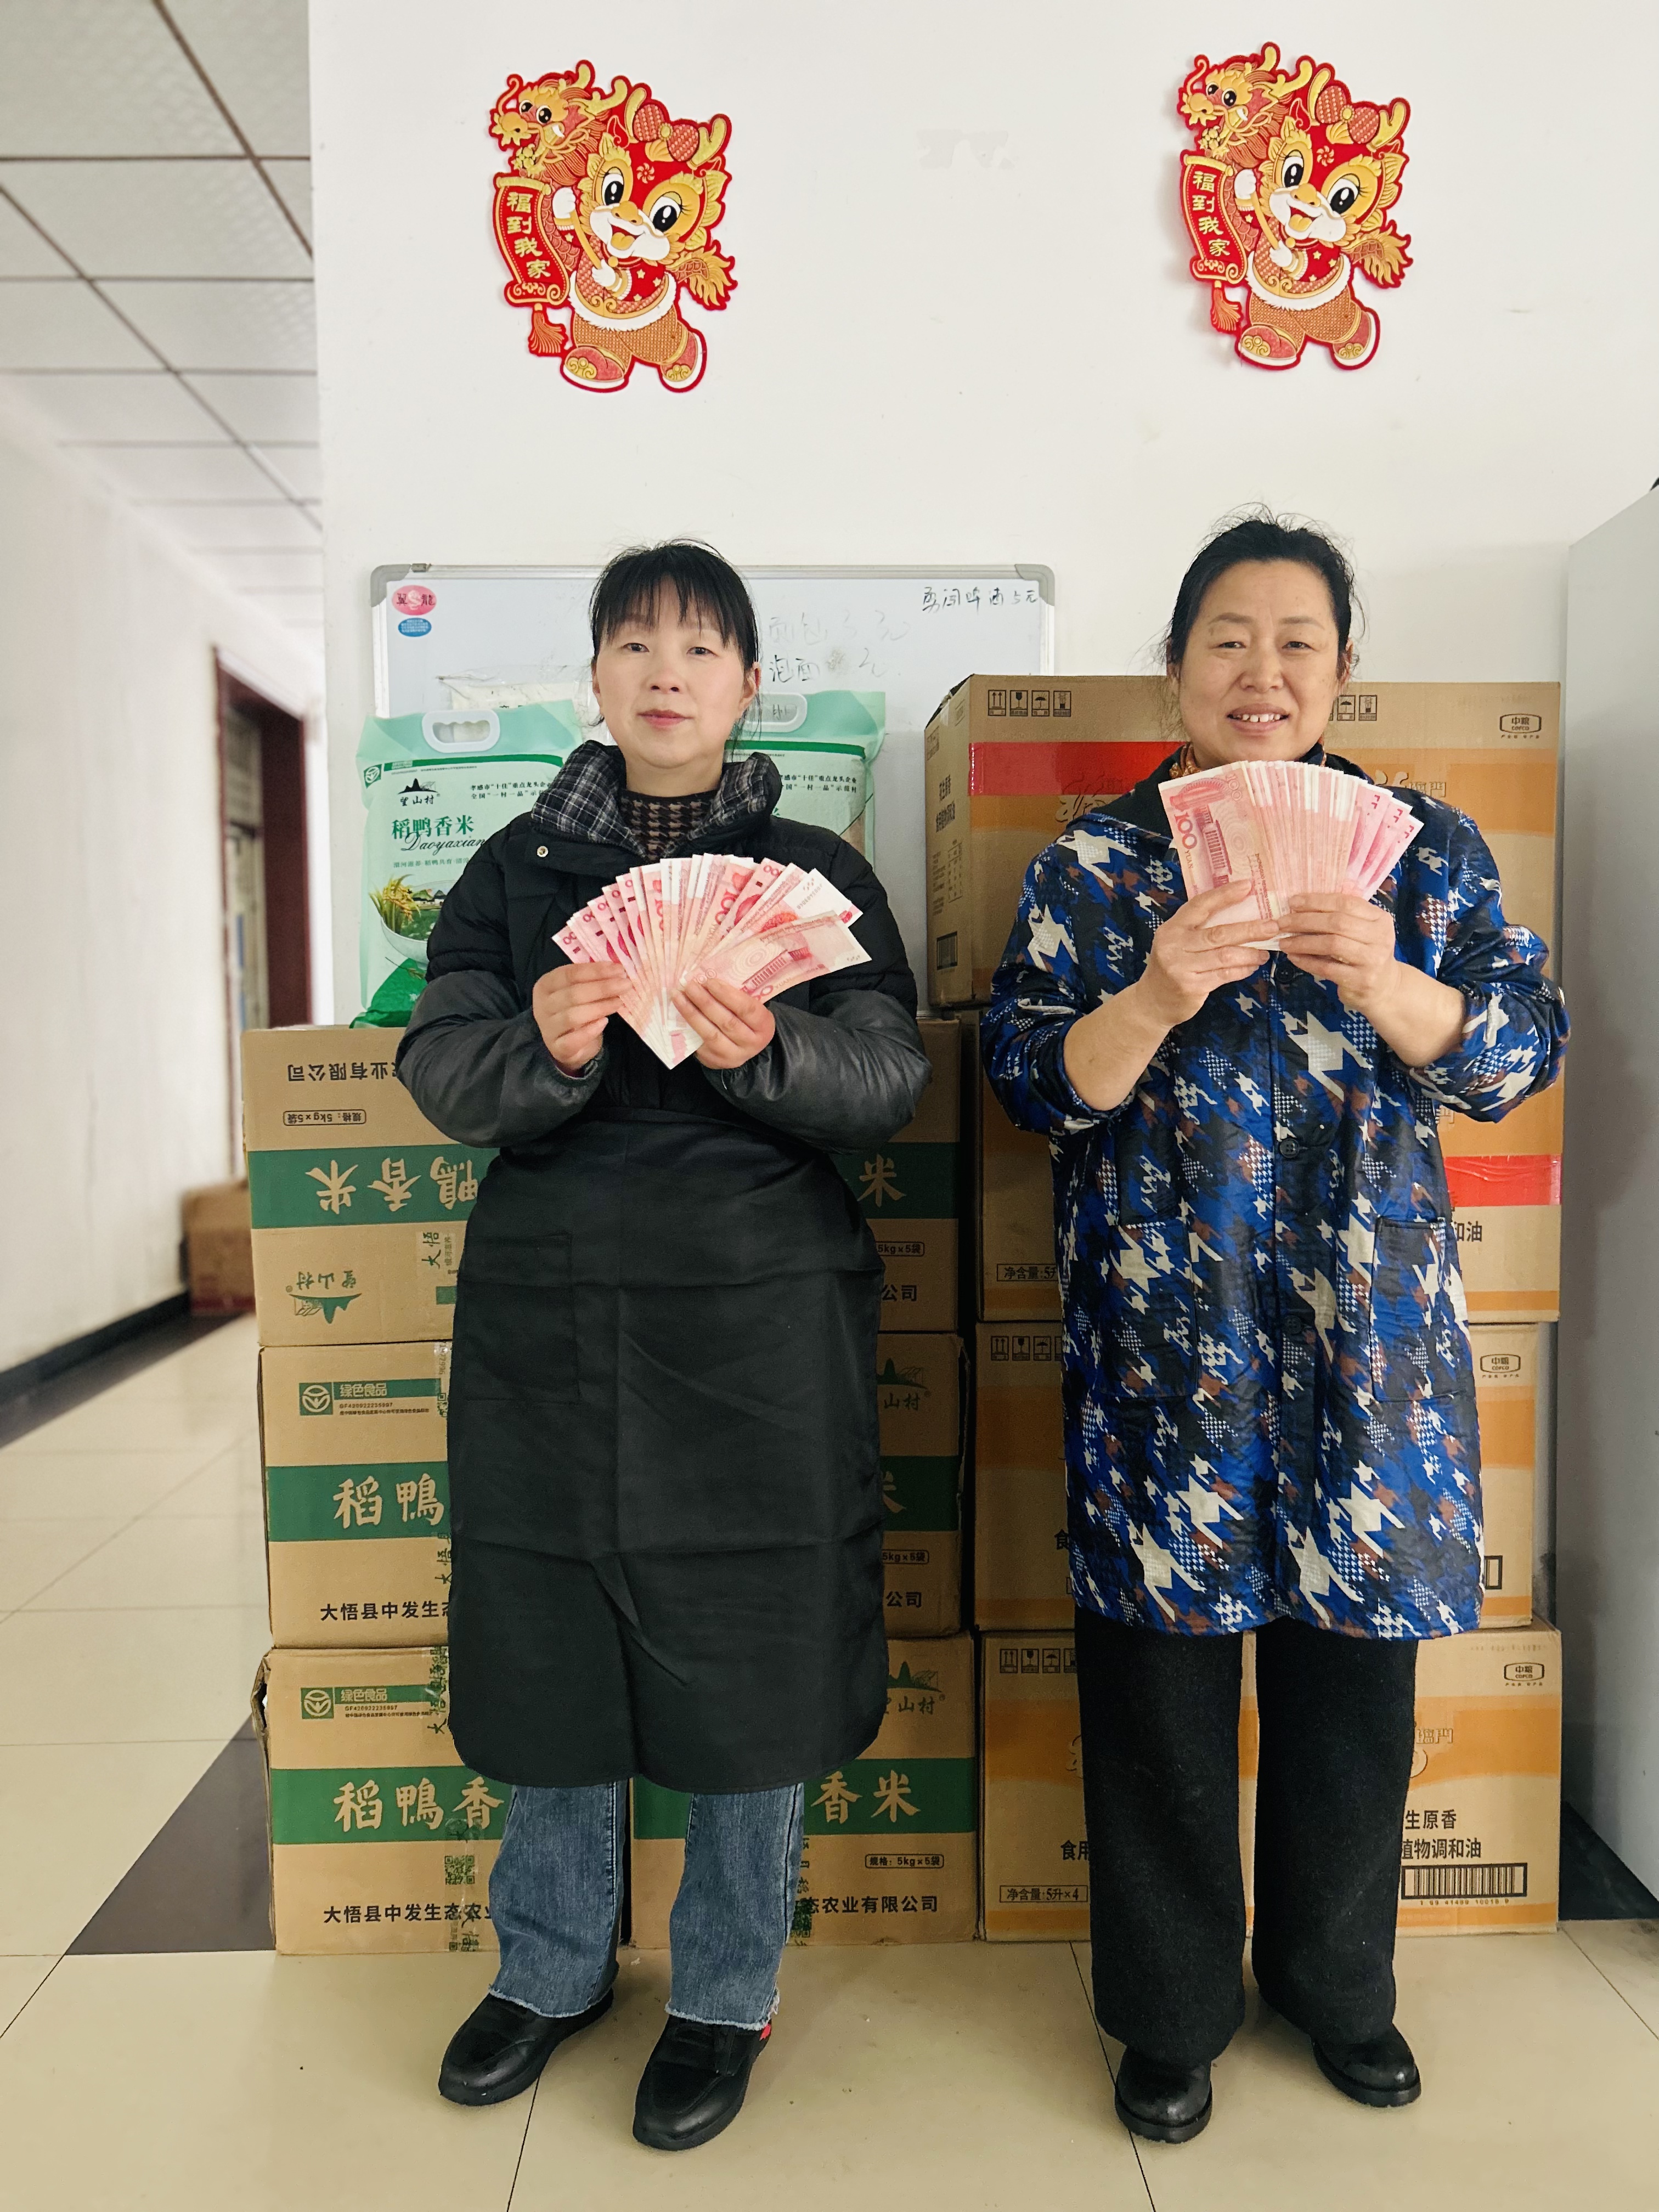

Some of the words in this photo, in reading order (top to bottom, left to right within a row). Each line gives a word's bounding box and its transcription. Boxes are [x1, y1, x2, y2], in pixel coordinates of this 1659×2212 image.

[1193, 171, 1230, 256] 福到我家
[506, 193, 551, 278] 福到我家
[400, 795, 434, 806] 望山村
[391, 814, 474, 839] 稻鸭香米
[1173, 812, 1198, 850] 100
[1184, 850, 1195, 870] YUAN
[857, 1153, 907, 1207] 米
[297, 1269, 357, 1290] 望山村
[882, 1284, 917, 1302] 公司
[340, 1383, 387, 1397] 绿色食品
[885, 1591, 922, 1608] 公司
[341, 1688, 387, 1702] 绿色食品
[810, 1770, 922, 1824] 香米
[1405, 1809, 1457, 1830] 生原香
